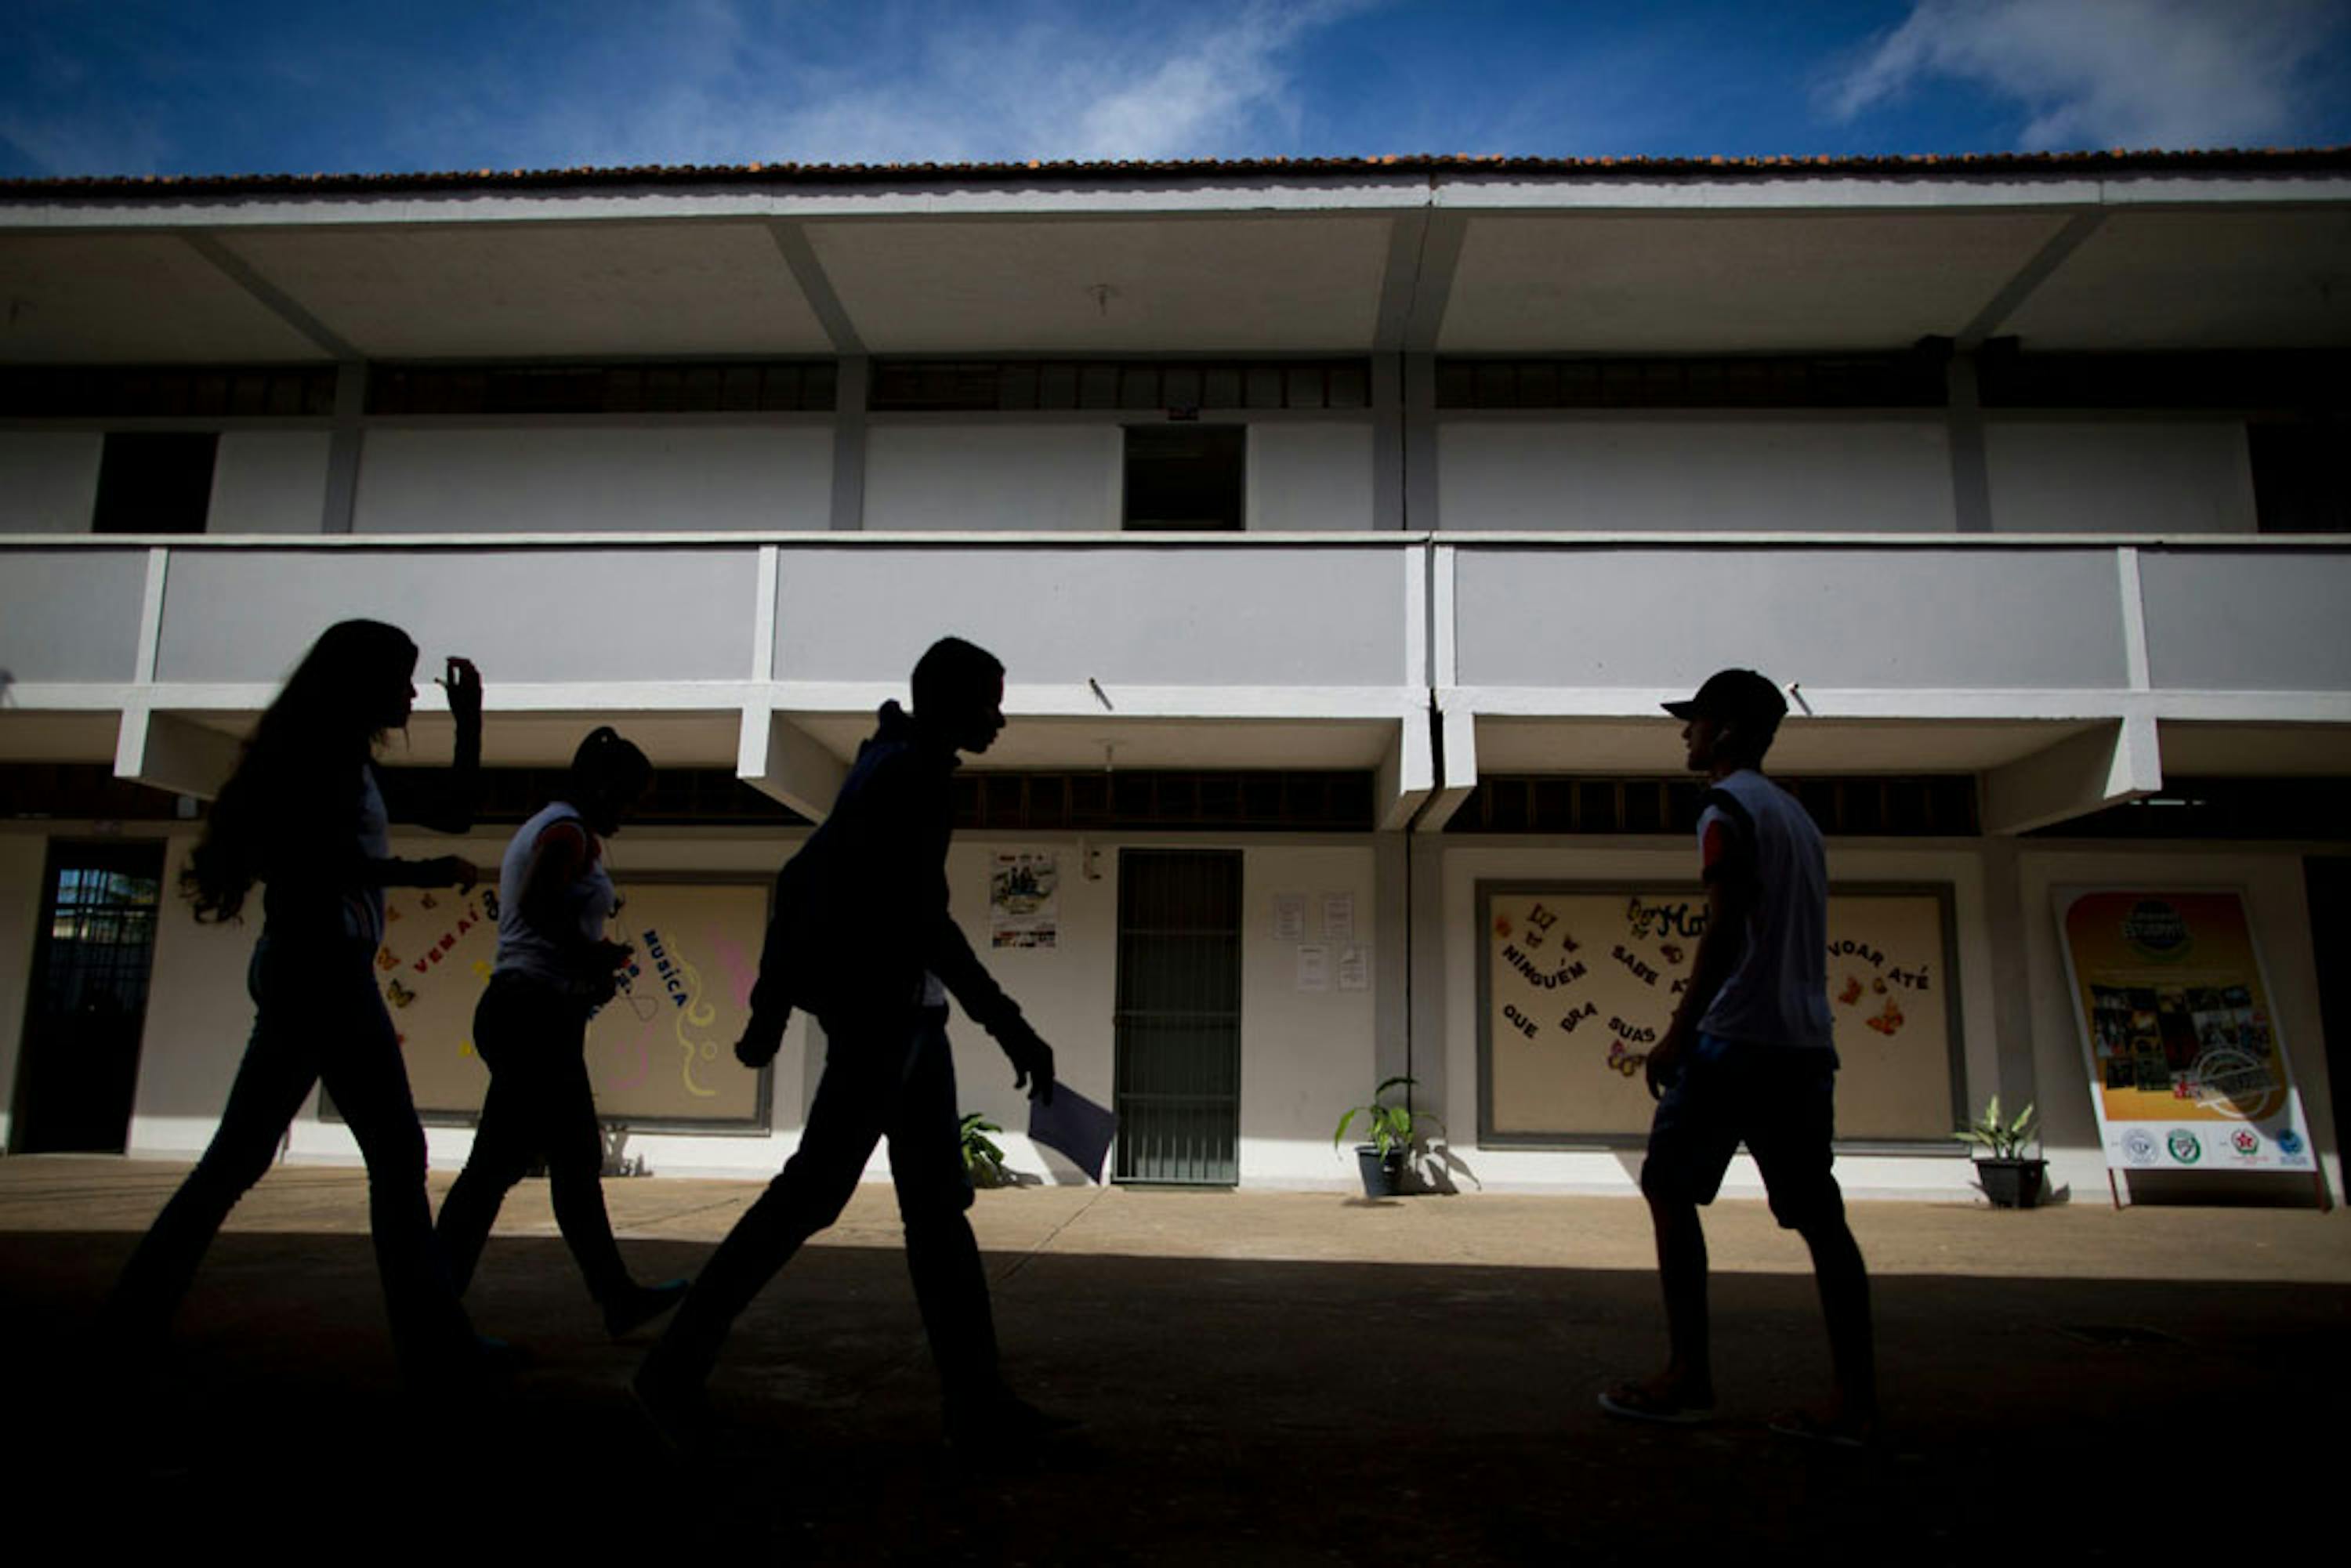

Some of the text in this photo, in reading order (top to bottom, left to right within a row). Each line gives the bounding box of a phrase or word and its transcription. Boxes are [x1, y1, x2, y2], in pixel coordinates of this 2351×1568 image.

[1502, 944, 1587, 989] NINGUÉM
[1612, 945, 1659, 986] SABE
[1828, 940, 1929, 990] VOAR ATÉ
[1504, 1005, 1538, 1038] QUE
[1608, 1016, 1656, 1044] SUAS
